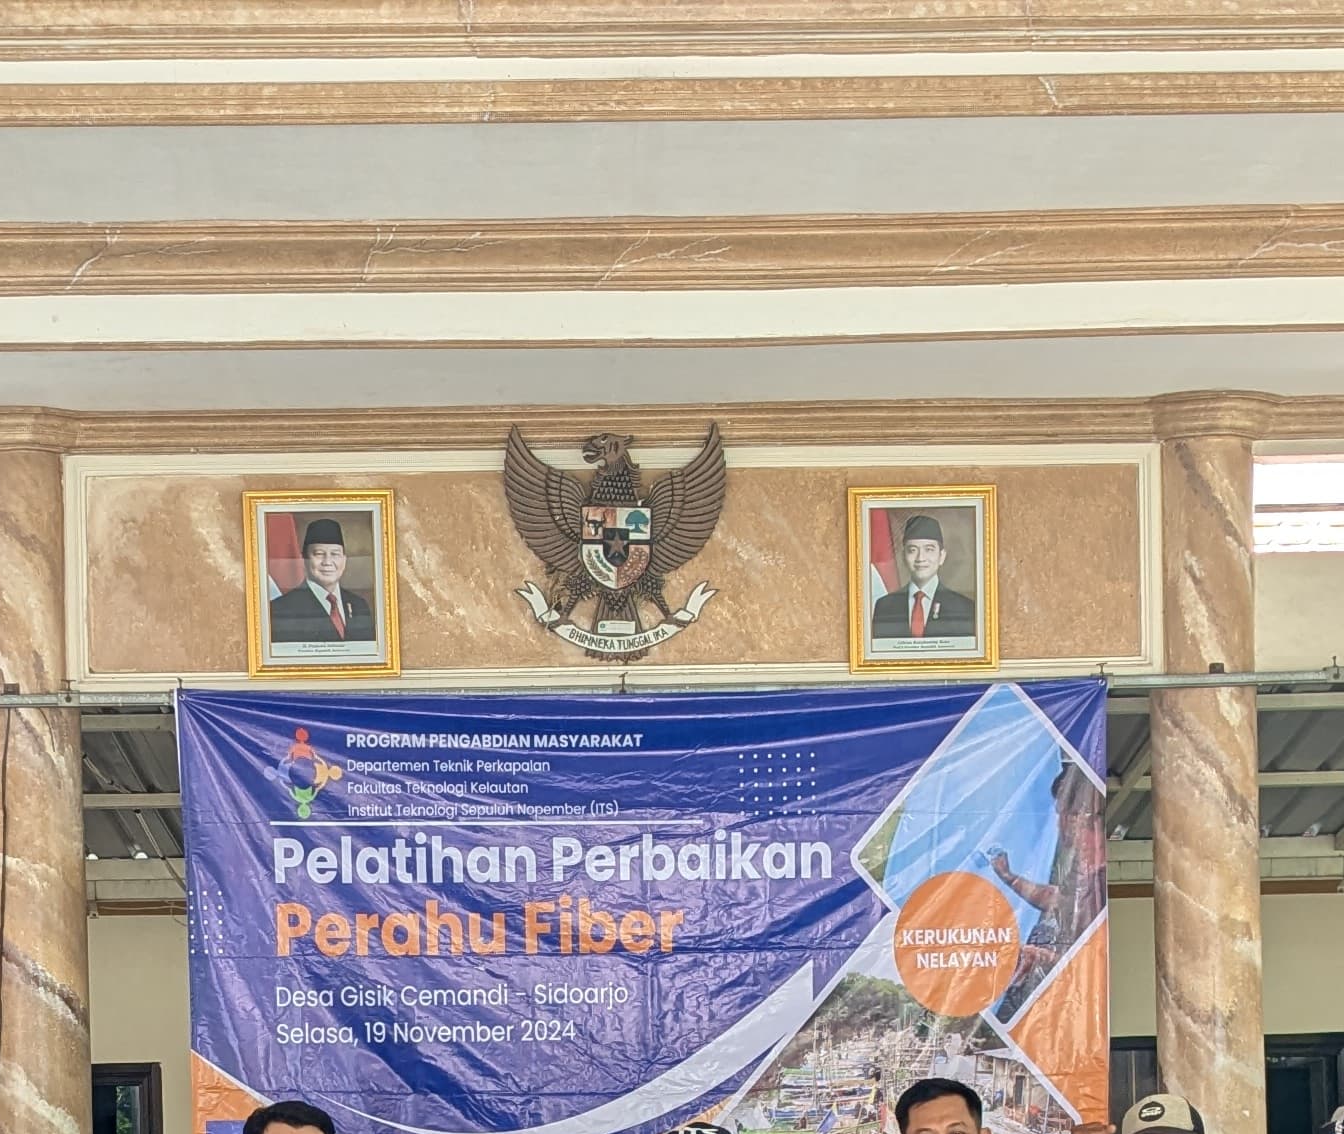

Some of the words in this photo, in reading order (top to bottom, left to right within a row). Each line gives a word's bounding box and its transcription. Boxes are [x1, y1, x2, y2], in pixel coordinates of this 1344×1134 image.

[568, 628, 616, 650] BHINNEKA
[617, 633, 654, 650] TUNGGAL
[654, 627, 669, 643] IKA
[346, 733, 426, 748] PROGRAM
[429, 733, 531, 748] PENGABDIAN
[534, 733, 643, 748] MASYARAKAT
[347, 759, 430, 775] Departemen
[433, 759, 474, 772] Teknik
[476, 759, 550, 775] Perkapalan
[347, 781, 402, 794] Fakultas
[405, 781, 467, 797] Teknologi
[470, 781, 528, 794] Kelautan
[348, 803, 393, 817] Institut
[395, 803, 458, 819] Teknologi
[460, 803, 514, 818] Sepuluh
[517, 802, 587, 818] Nopember
[590, 801, 619, 817] (ITS)
[273, 833, 537, 885] Pelatihan
[552, 829, 832, 882] Perbaikan
[276, 900, 506, 957] Perahu
[525, 894, 685, 955] Fiber
[902, 927, 1012, 945] KERUKUNAN
[916, 951, 998, 969] NELAYAN
[276, 985, 334, 1008] Desa
[340, 984, 394, 1007] Gisik
[400, 982, 509, 1006] Cemandi
[534, 981, 629, 1011] Sidoarjo
[276, 1022, 359, 1047] Selasa,
[364, 1022, 386, 1044] 19
[392, 1021, 515, 1043] November
[521, 1020, 576, 1042] 2024
